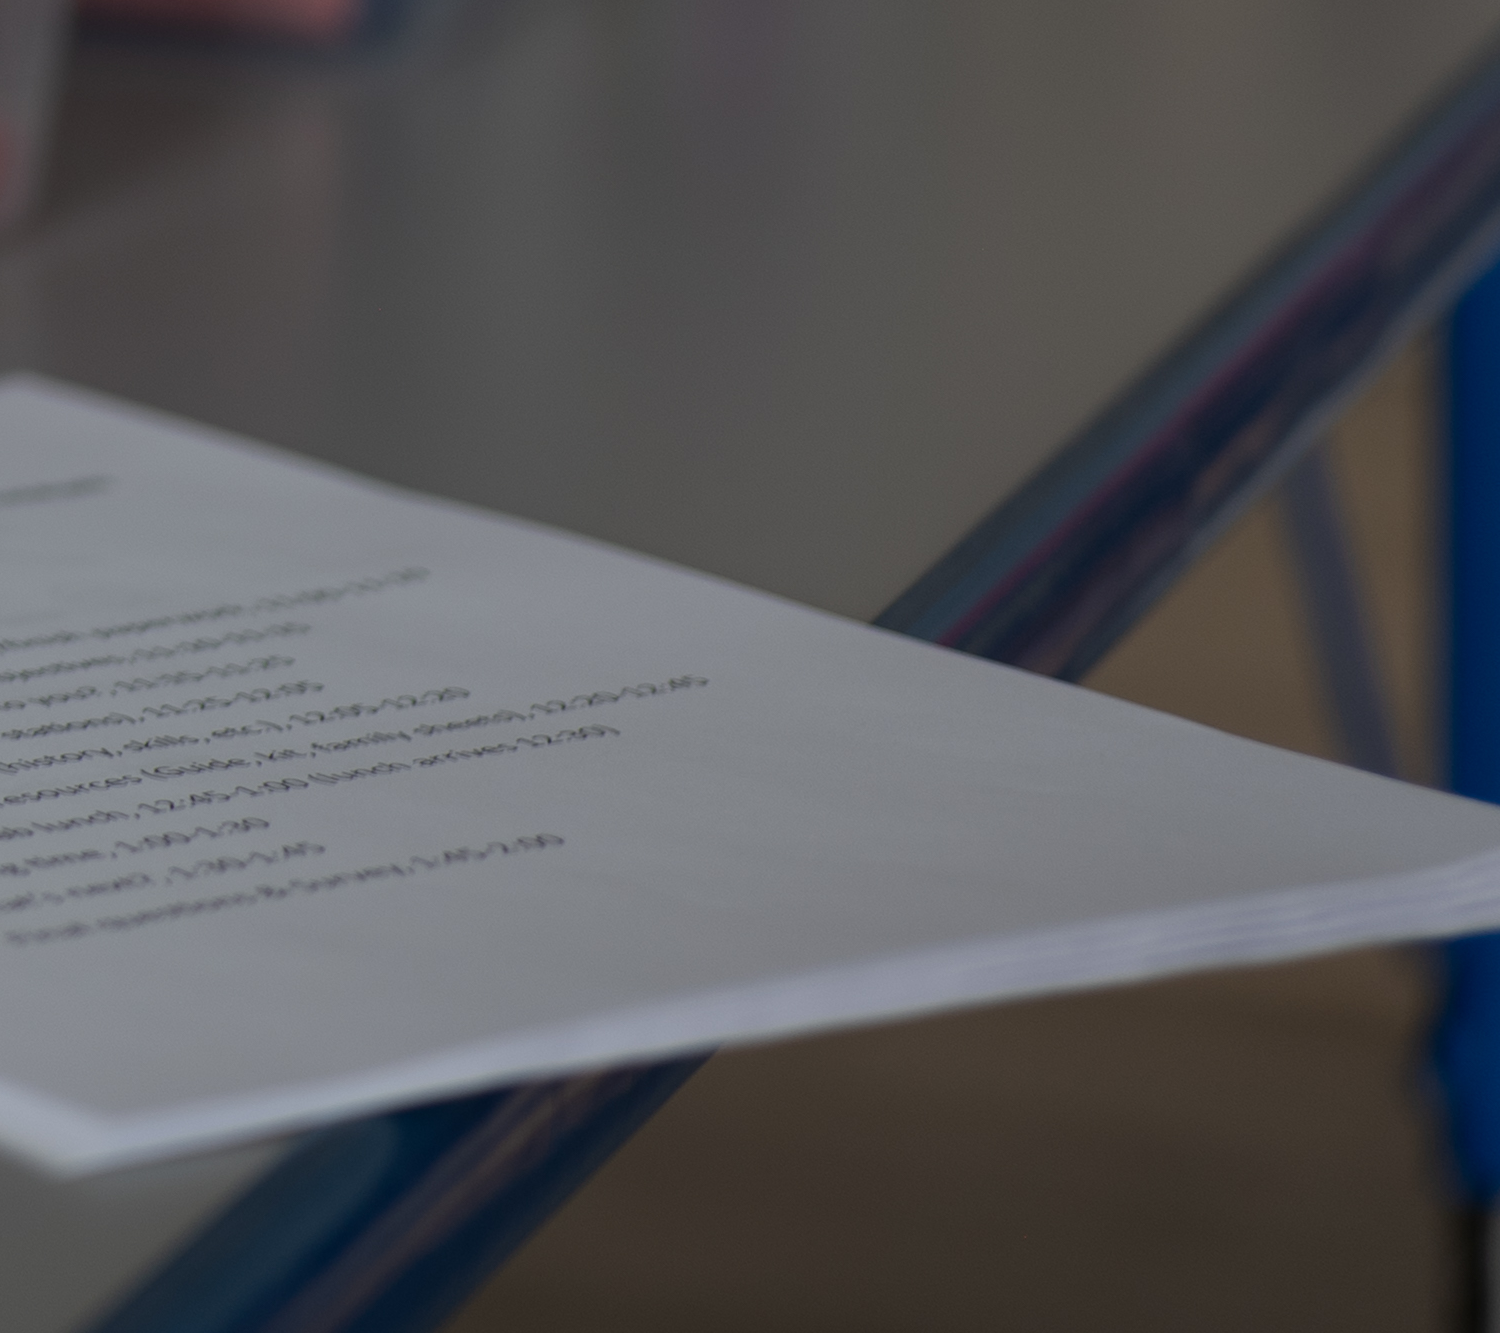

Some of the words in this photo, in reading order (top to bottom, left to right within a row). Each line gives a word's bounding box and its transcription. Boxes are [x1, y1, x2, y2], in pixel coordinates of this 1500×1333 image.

[118, 731, 208, 754] skills,
[142, 753, 260, 782] (Guide,
[255, 745, 313, 763] kit,
[309, 728, 412, 754] family
[33, 807, 138, 833] lunch,
[133, 776, 309, 813] 12:45-1:00
[307, 759, 412, 786] (lunch
[407, 741, 520, 767] arrives
[29, 845, 111, 871] time,
